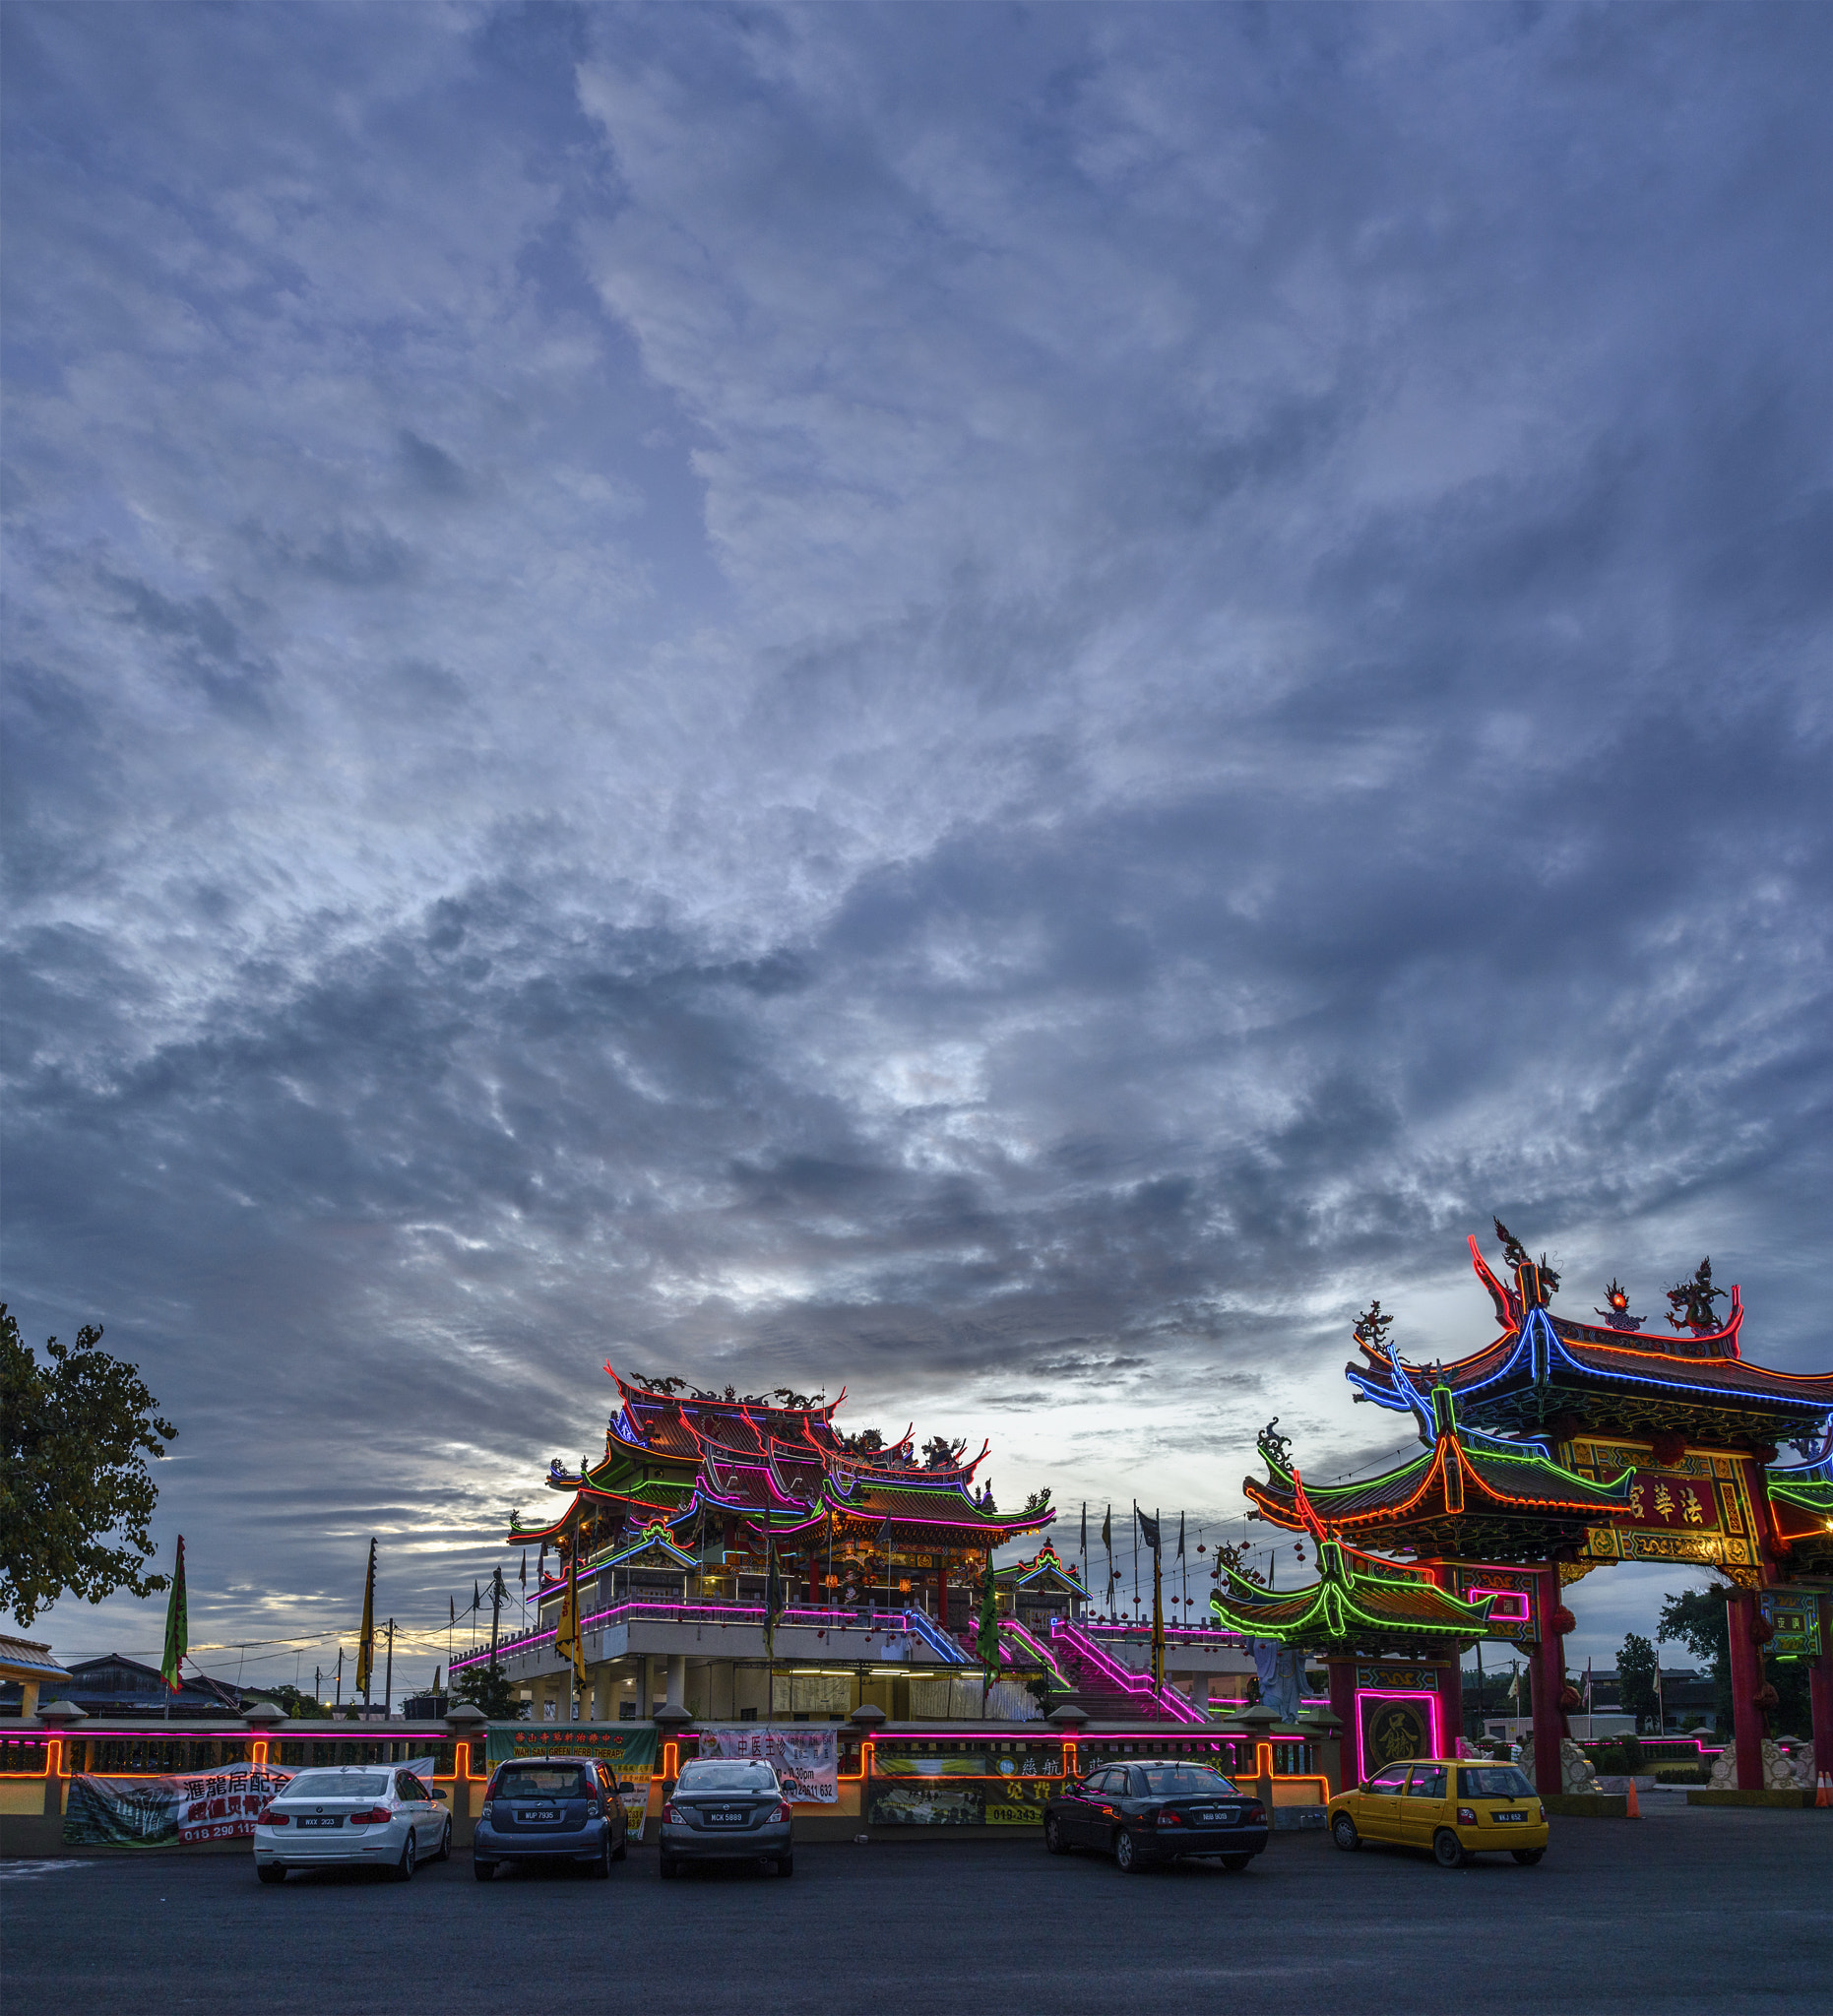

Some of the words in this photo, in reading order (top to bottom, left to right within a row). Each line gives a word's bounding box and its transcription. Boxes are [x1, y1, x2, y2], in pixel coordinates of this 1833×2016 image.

[515, 1747, 530, 1757] WAH
[532, 1747, 546, 1757] SAN
[548, 1747, 571, 1757] GREEN
[574, 1747, 592, 1757] HERB
[594, 1748, 625, 1759] THERAPY
[820, 1784, 833, 1796] 632
[185, 1828, 210, 1841] 018
[214, 1825, 234, 1838] 290
